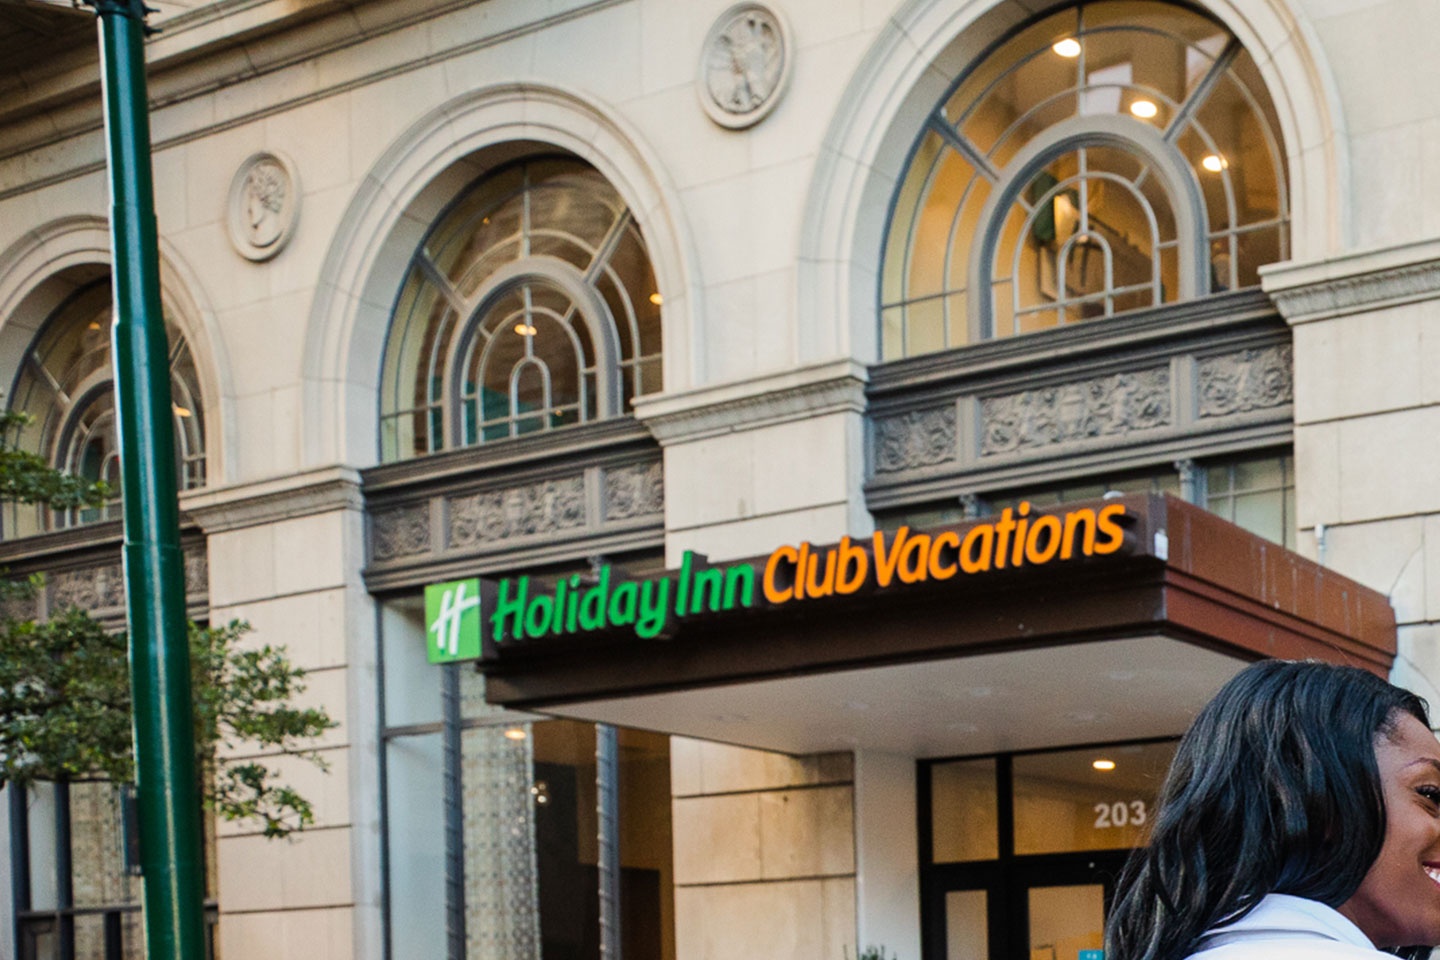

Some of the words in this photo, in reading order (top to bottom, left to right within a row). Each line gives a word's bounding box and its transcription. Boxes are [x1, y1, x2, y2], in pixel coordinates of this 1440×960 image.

[490, 564, 670, 639] Holiday
[675, 550, 755, 617] Inn
[763, 536, 869, 604] Club
[873, 501, 1126, 588] Vacations
[1094, 800, 1147, 829] 203
